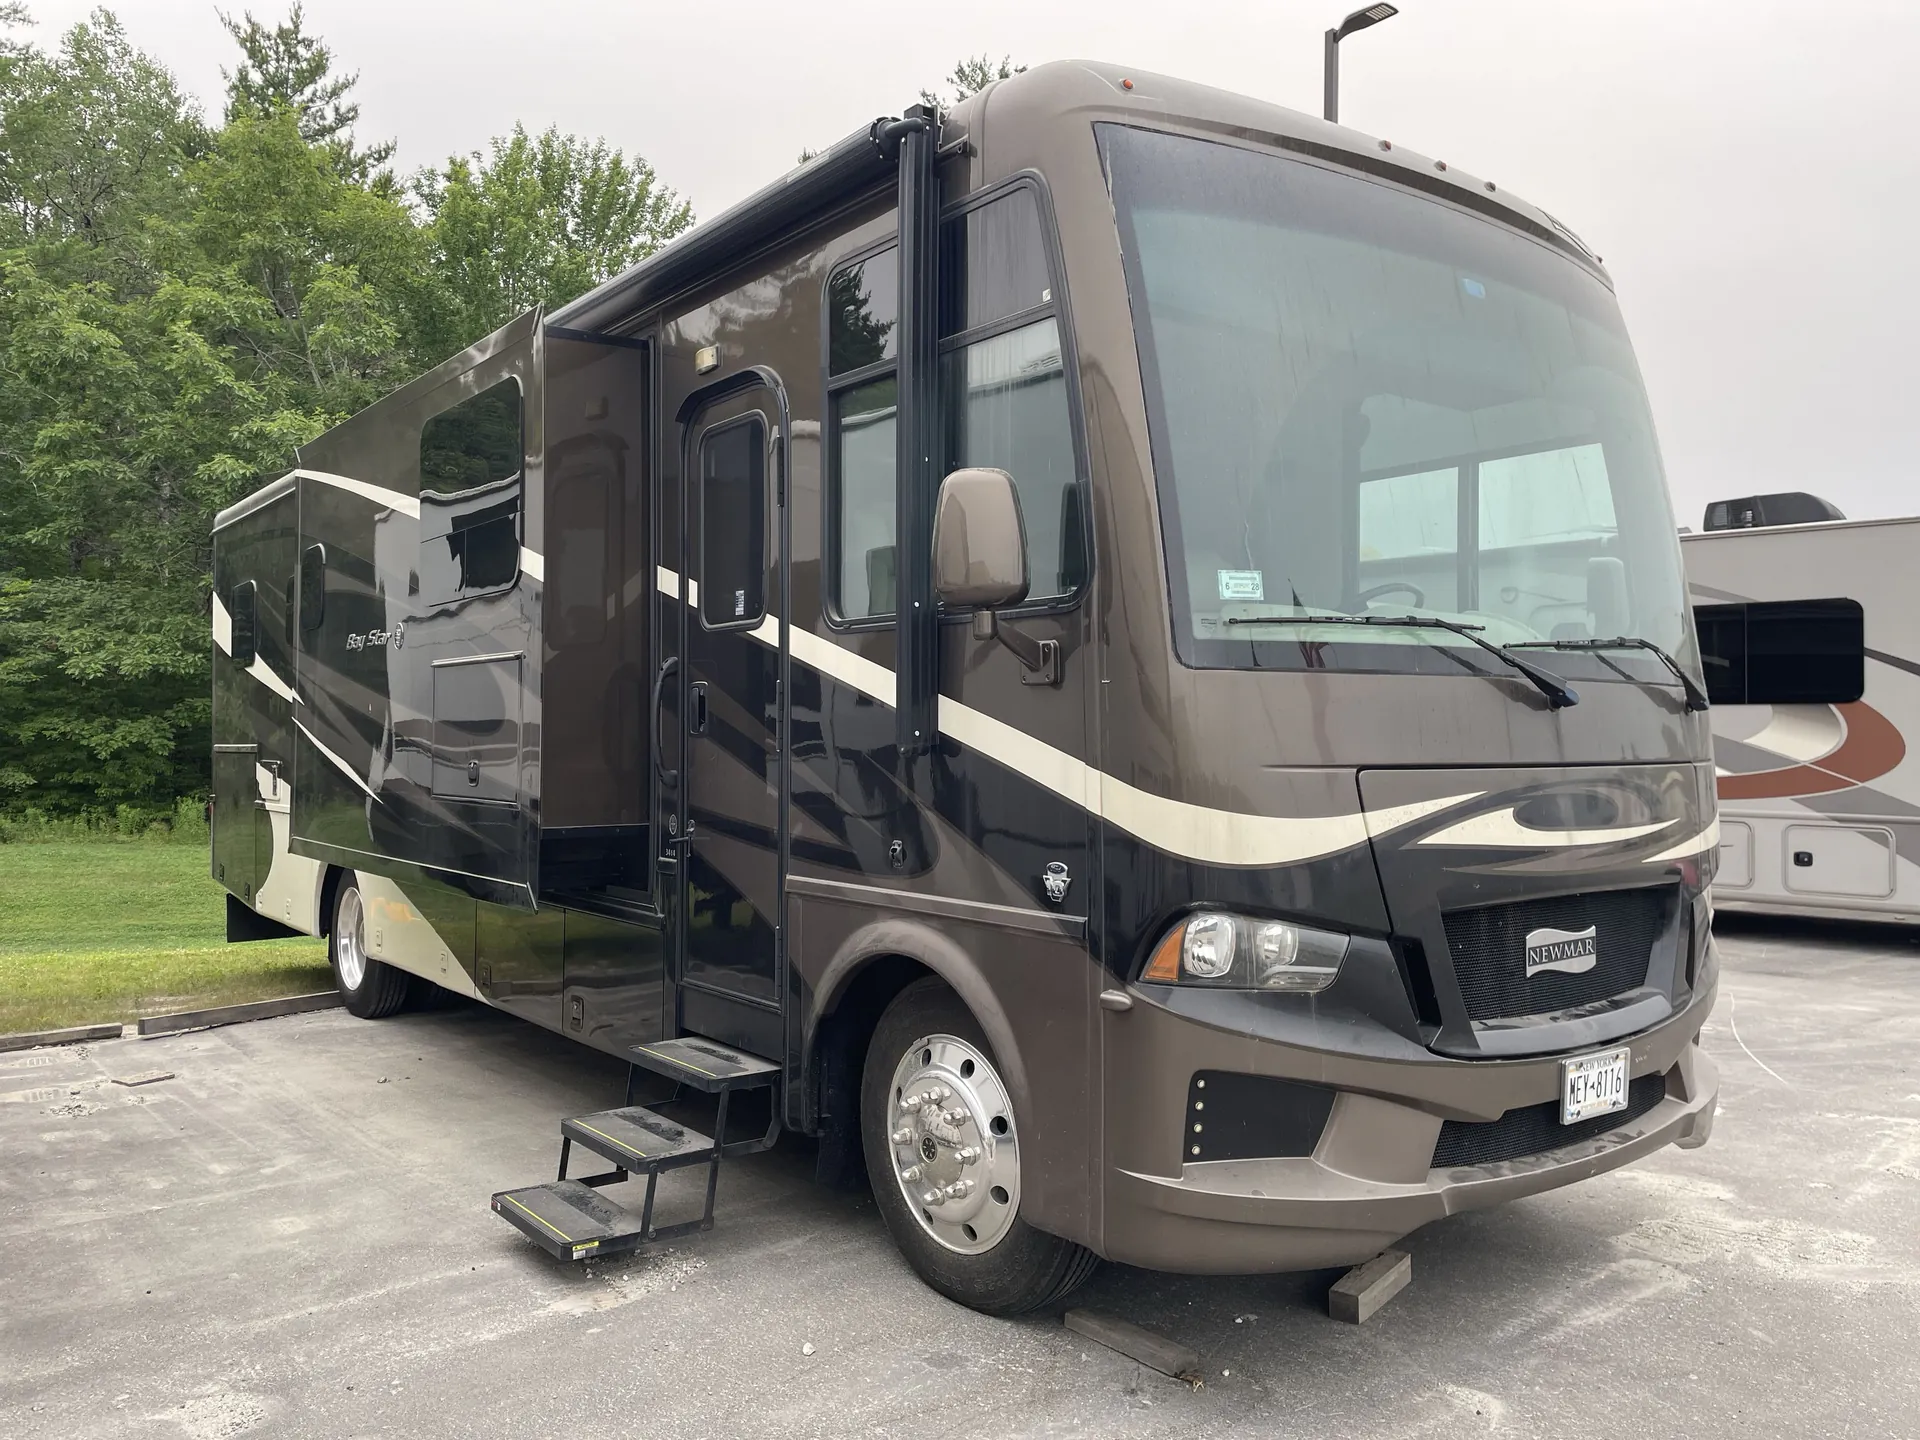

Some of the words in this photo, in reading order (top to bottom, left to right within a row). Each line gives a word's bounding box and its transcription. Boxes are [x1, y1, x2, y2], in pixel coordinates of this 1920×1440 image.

[346, 633, 366, 652] Bay
[367, 628, 392, 647] Star
[1529, 938, 1595, 965] NEWMAR
